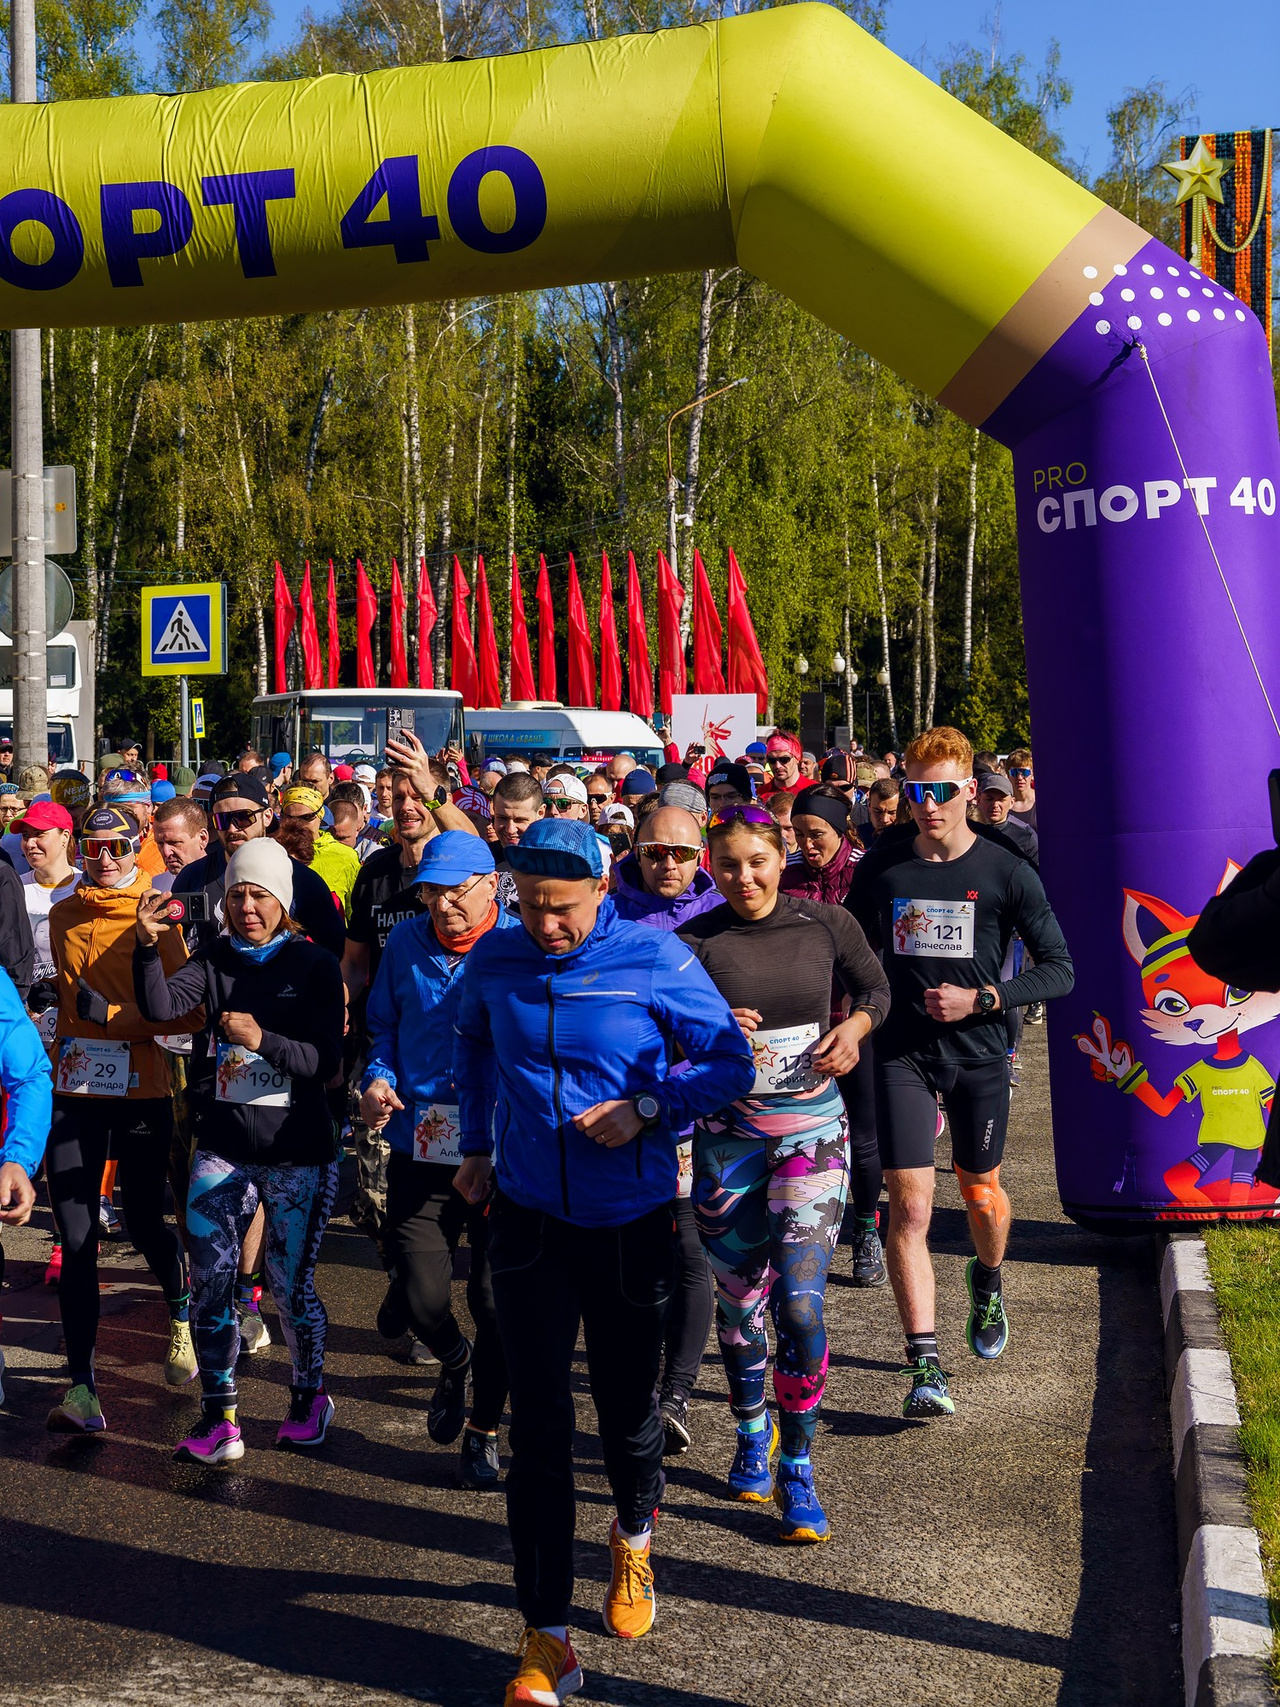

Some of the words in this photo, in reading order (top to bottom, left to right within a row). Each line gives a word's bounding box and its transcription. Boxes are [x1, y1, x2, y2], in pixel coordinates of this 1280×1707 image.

[340, 144, 548, 265] 40
[1033, 462, 1087, 493] PRO
[1037, 476, 1217, 533] СПОРТ
[1229, 476, 1276, 516] 40
[933, 924, 963, 940] 121
[914, 940, 962, 950] Вячеслав
[769, 1037, 791, 1045] СПОРТ
[779, 1052, 813, 1072] 173
[94, 1062, 117, 1079] 29
[70, 1077, 124, 1091] Александра
[249, 1071, 284, 1088] 190
[768, 1074, 806, 1085] София
[1212, 1088, 1239, 1096] СПОРТ
